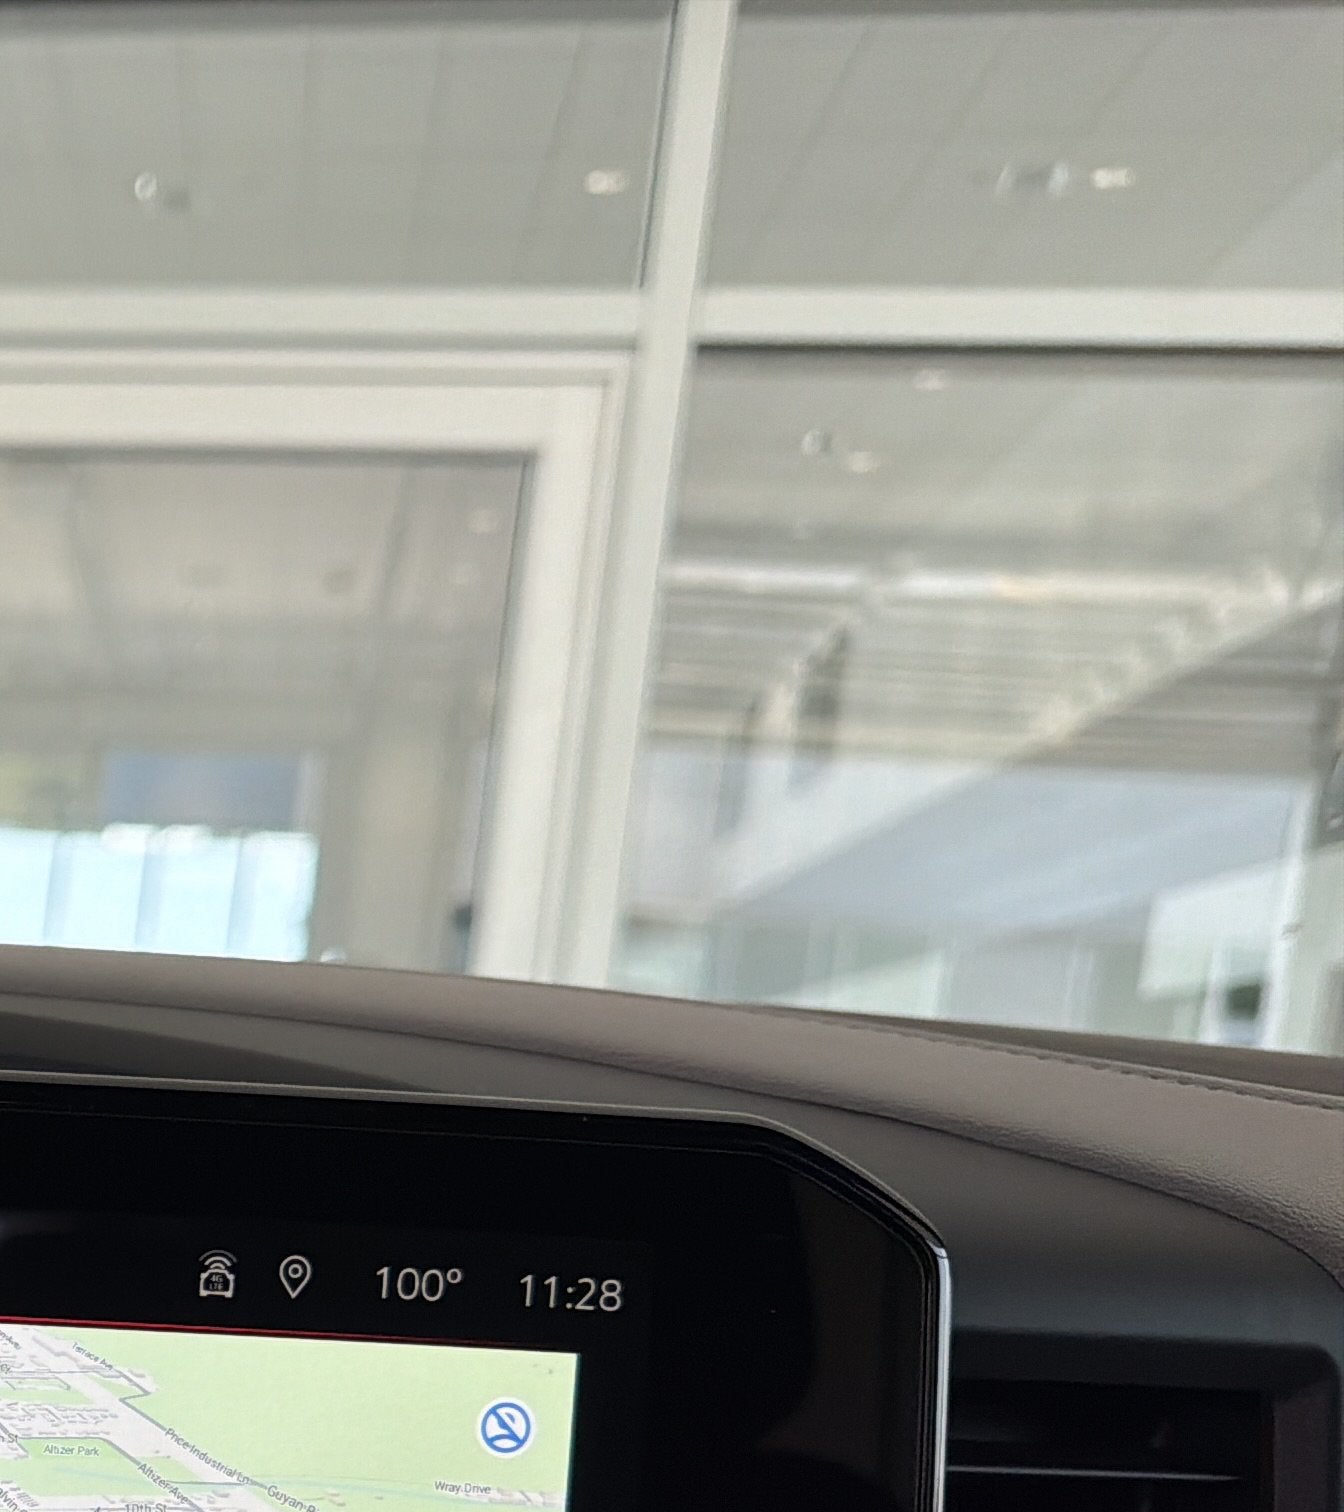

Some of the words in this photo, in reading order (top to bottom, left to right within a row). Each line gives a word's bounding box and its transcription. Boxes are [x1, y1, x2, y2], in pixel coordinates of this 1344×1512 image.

[520, 1274, 623, 1312] 11:28
[6, 1433, 19, 1443] St
[77, 1445, 101, 1457] Park
[190, 1443, 238, 1478] Industrial
[434, 1480, 462, 1496] Wray
[464, 1482, 492, 1495] Drive
